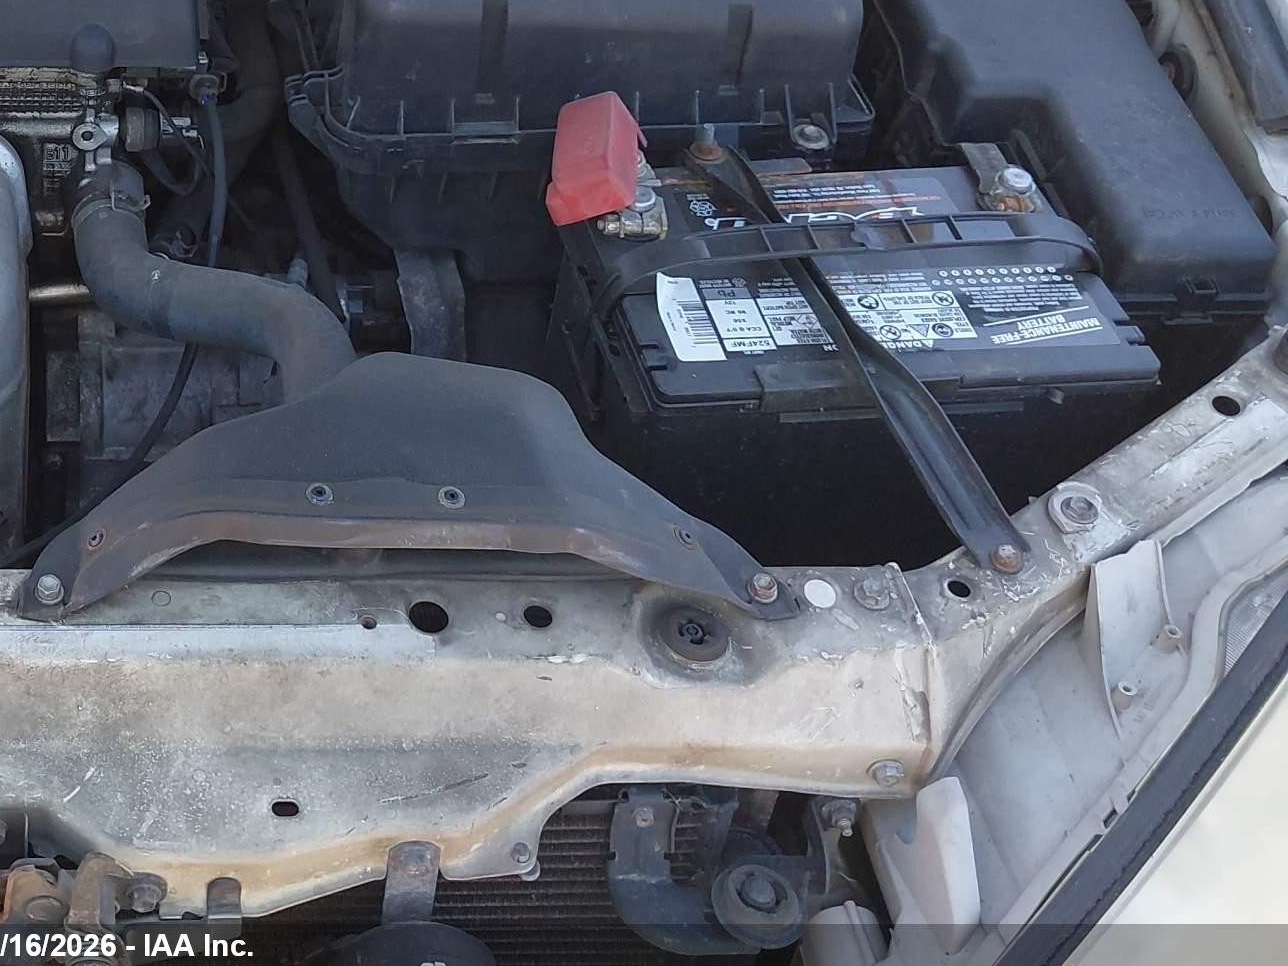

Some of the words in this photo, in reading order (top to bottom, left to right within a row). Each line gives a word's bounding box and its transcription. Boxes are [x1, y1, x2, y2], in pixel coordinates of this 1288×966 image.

[717, 289, 736, 297] Pb
[990, 317, 1101, 344] MAINTENANCE-FREE
[1016, 314, 1066, 331] BATTERY
